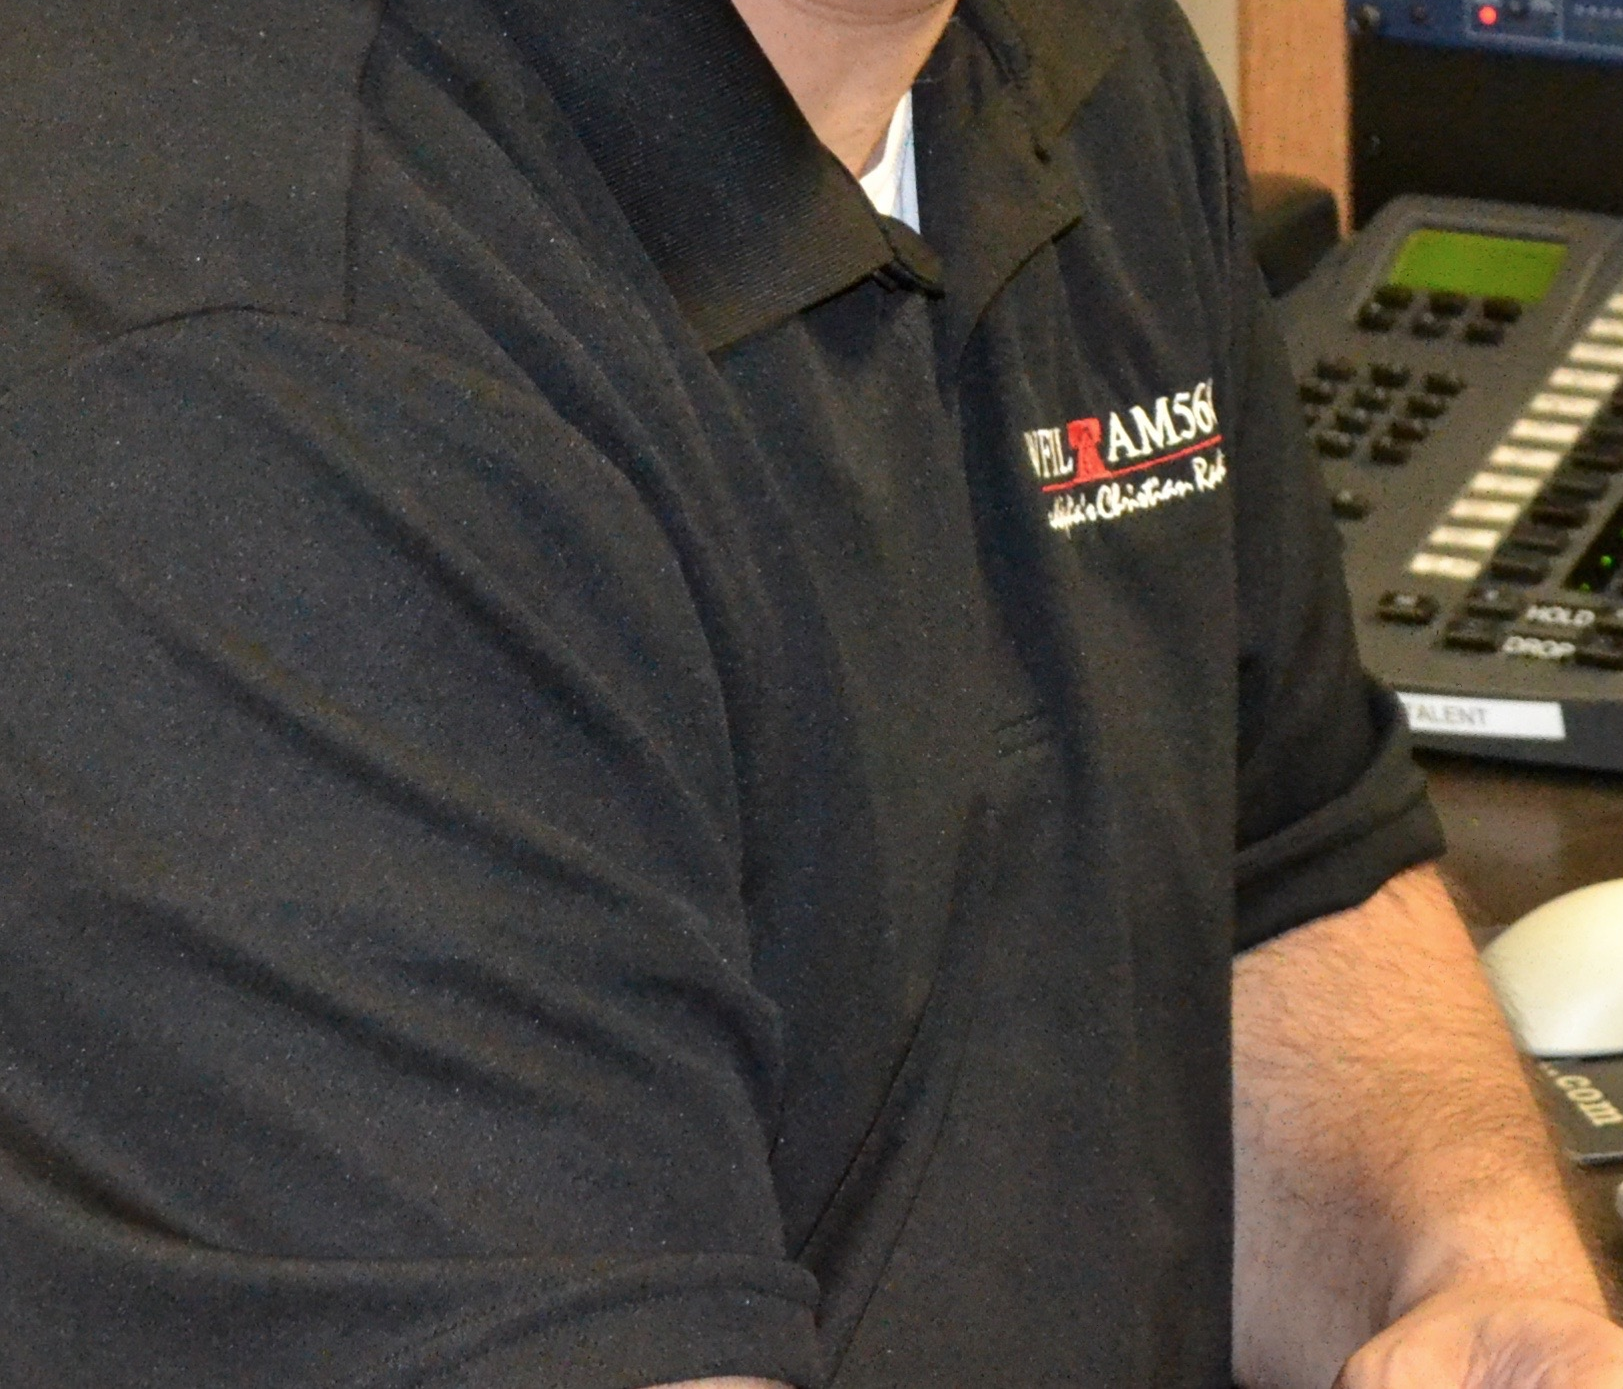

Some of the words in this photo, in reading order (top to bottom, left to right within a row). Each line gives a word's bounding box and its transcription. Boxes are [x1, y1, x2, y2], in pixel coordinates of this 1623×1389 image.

[1096, 475, 1194, 519] Christian
[1525, 604, 1597, 628] HOLD
[1501, 635, 1577, 660] DROP
[1407, 703, 1489, 727] ALENT
